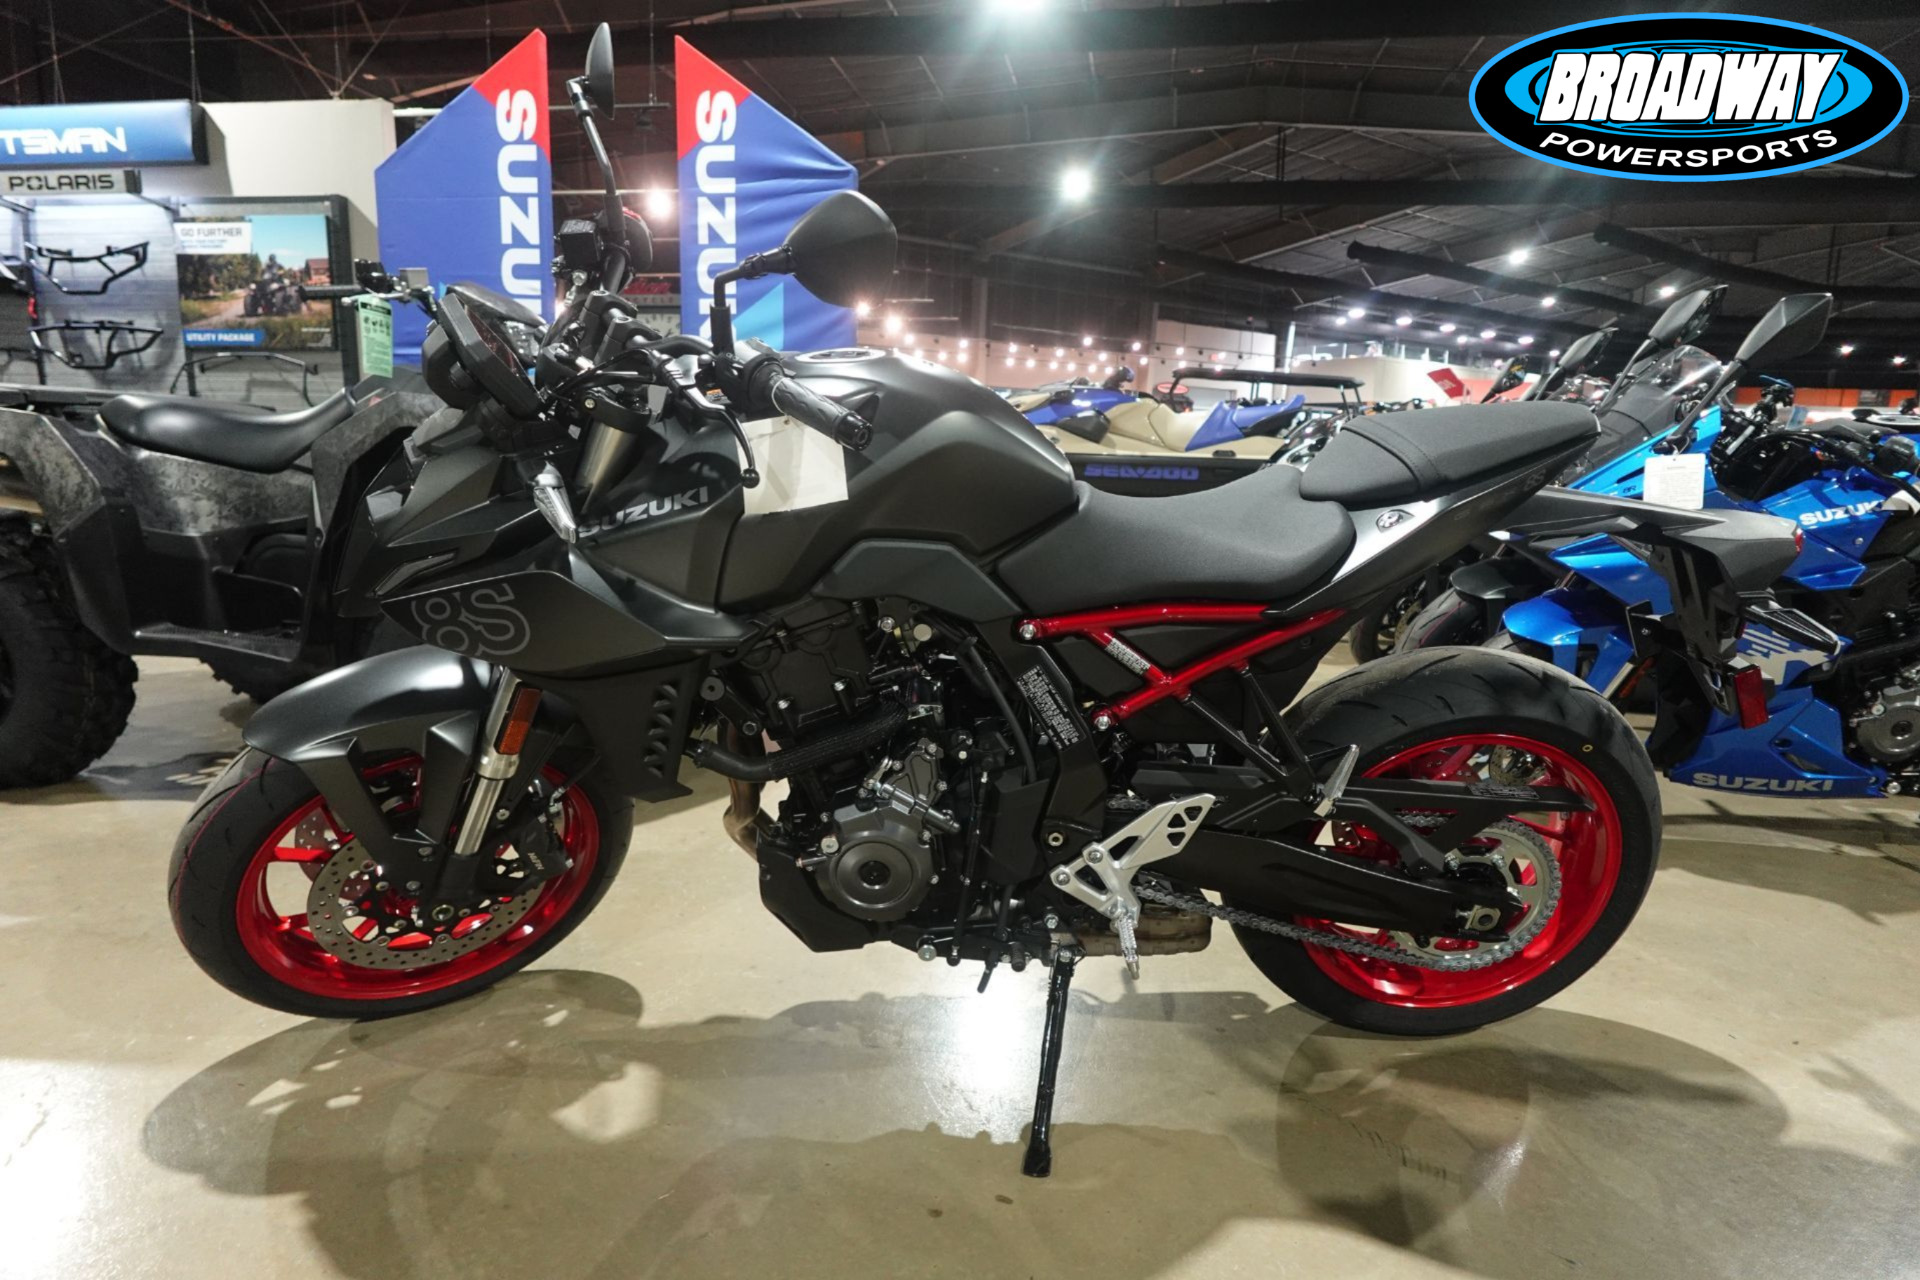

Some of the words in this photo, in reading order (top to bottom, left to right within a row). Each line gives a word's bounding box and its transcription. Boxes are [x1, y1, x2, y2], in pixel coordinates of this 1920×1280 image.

[8, 174, 114, 191] POLARIS
[496, 88, 542, 316] SUZU
[197, 227, 242, 237] FURTHER
[186, 333, 216, 342] UTILITY
[217, 333, 255, 342] PACKAGE
[577, 486, 709, 539] SUZUKI
[1692, 772, 1834, 792] SUZUKI
